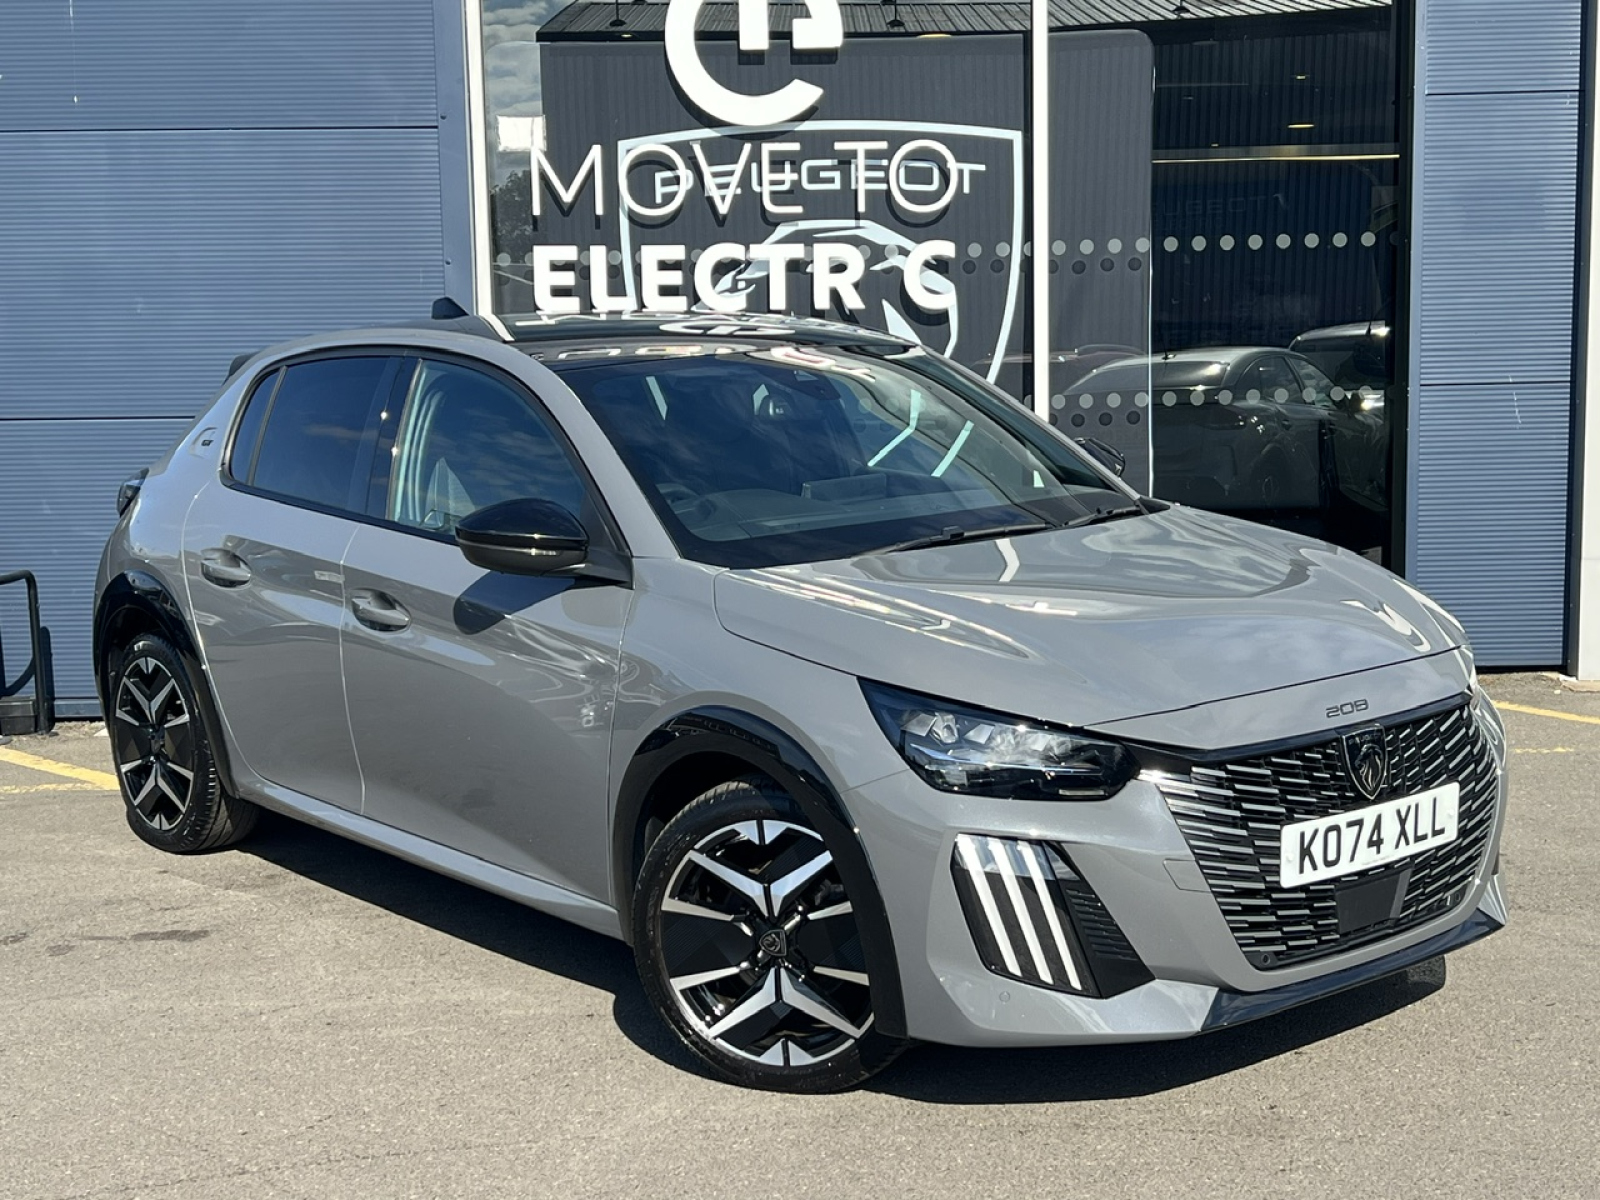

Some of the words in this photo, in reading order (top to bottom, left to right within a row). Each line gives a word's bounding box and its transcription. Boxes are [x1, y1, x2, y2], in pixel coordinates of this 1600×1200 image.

[530, 141, 803, 217] MOVE
[833, 138, 959, 214] TO
[653, 158, 986, 204] PEUGEOT
[1325, 698, 1369, 718] 208
[1395, 796, 1446, 850] XLL
